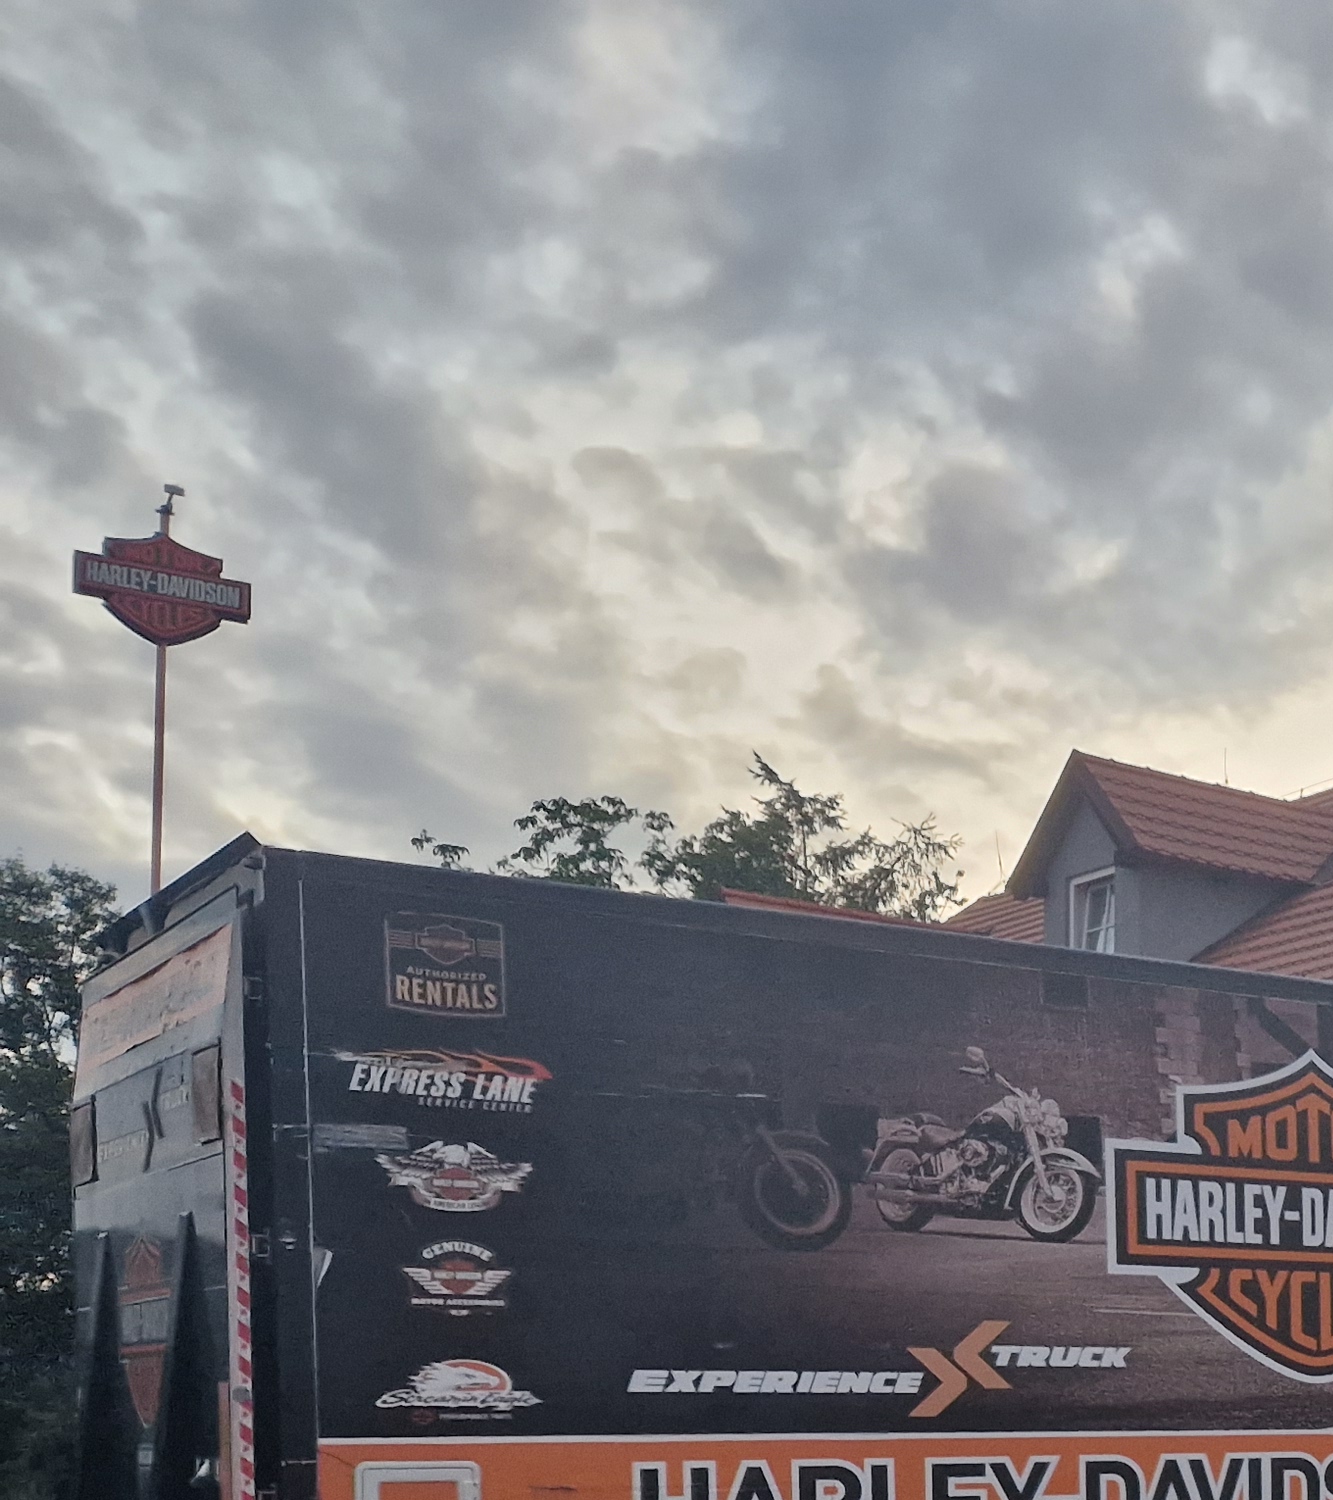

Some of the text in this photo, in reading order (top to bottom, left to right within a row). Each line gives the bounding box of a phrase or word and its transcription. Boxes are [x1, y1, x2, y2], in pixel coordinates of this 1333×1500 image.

[86, 560, 241, 609] HARLEY-DAVIDSON
[395, 974, 499, 1010] RENTALS
[406, 965, 487, 982] AUTHORIZED
[348, 1063, 539, 1104] EXPRESS LANE
[627, 1368, 925, 1394] EXPERIENCE
[990, 1344, 1132, 1369] TRUCK
